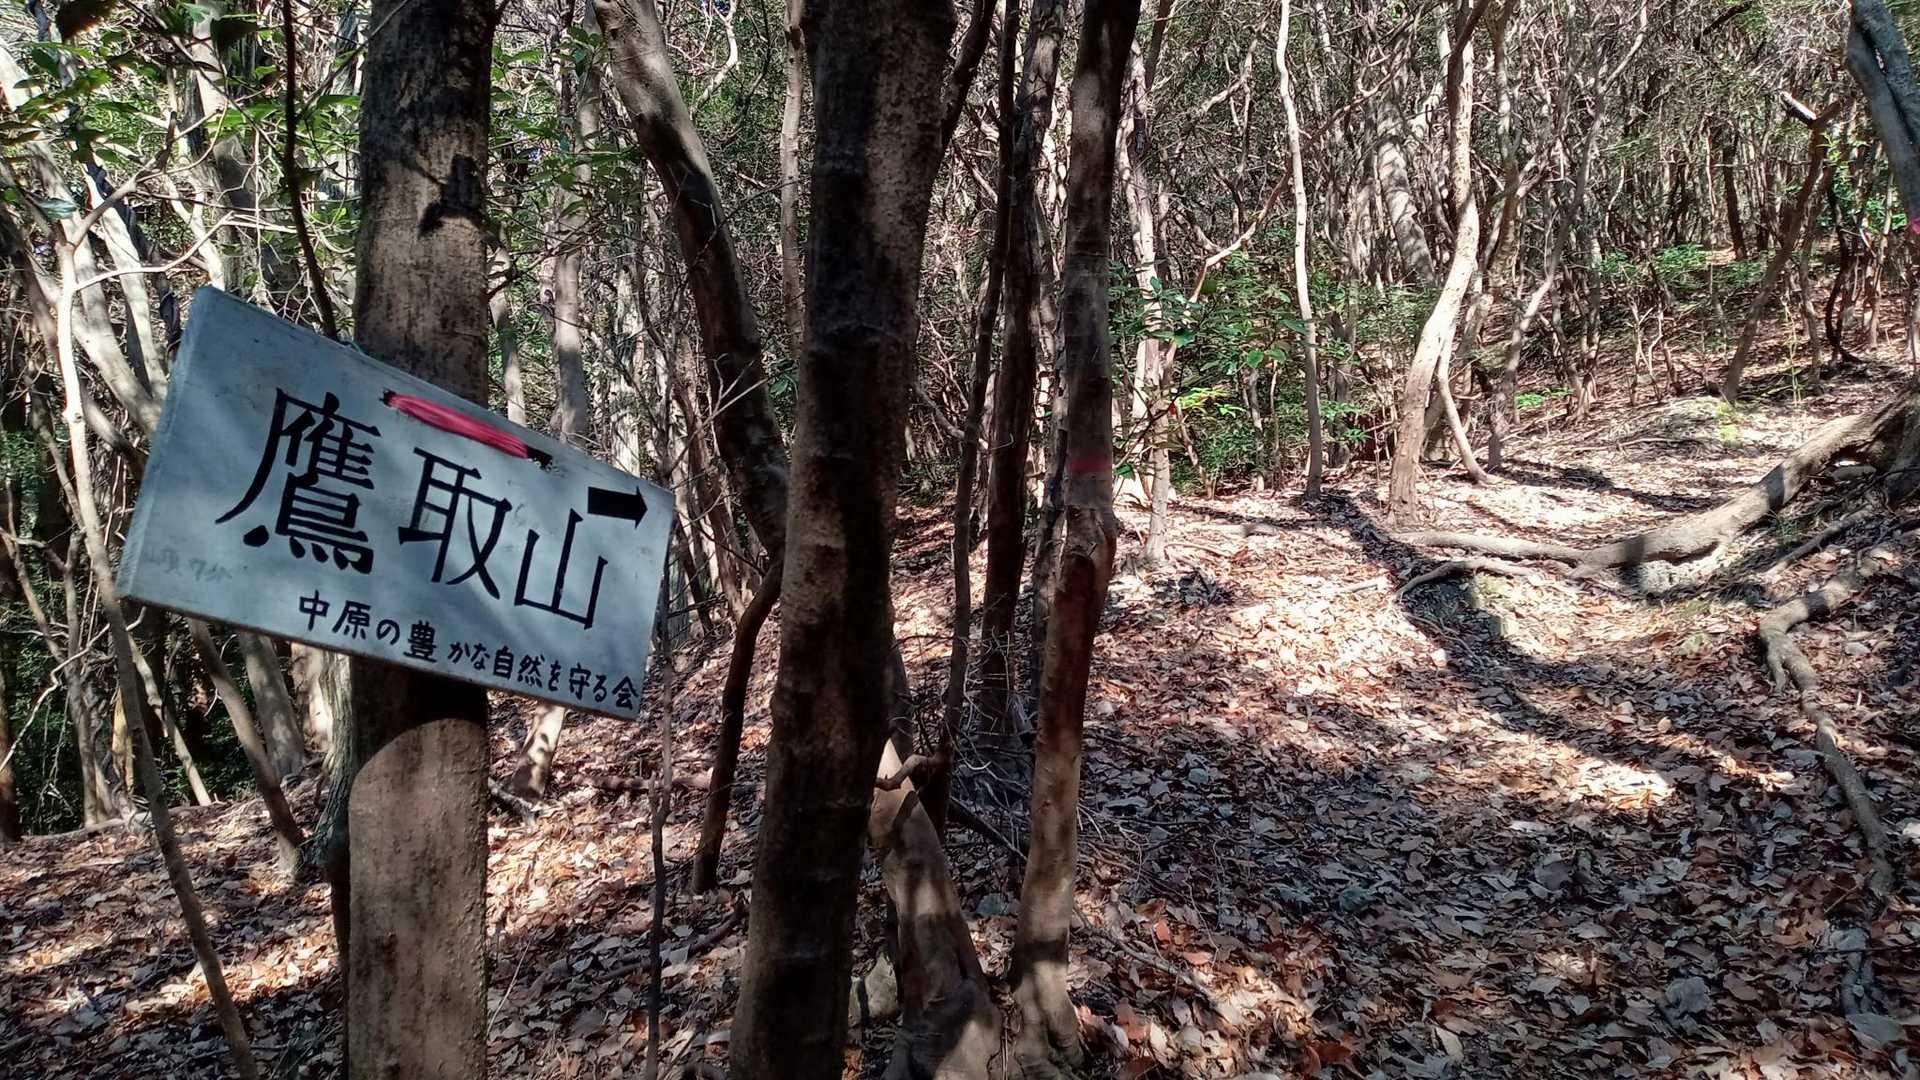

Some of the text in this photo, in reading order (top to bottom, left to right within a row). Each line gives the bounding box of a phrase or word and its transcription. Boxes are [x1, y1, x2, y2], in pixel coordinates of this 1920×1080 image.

[215, 388, 609, 630] 鷹取山
[299, 590, 639, 710] 中原の豊かな自然を守る会
